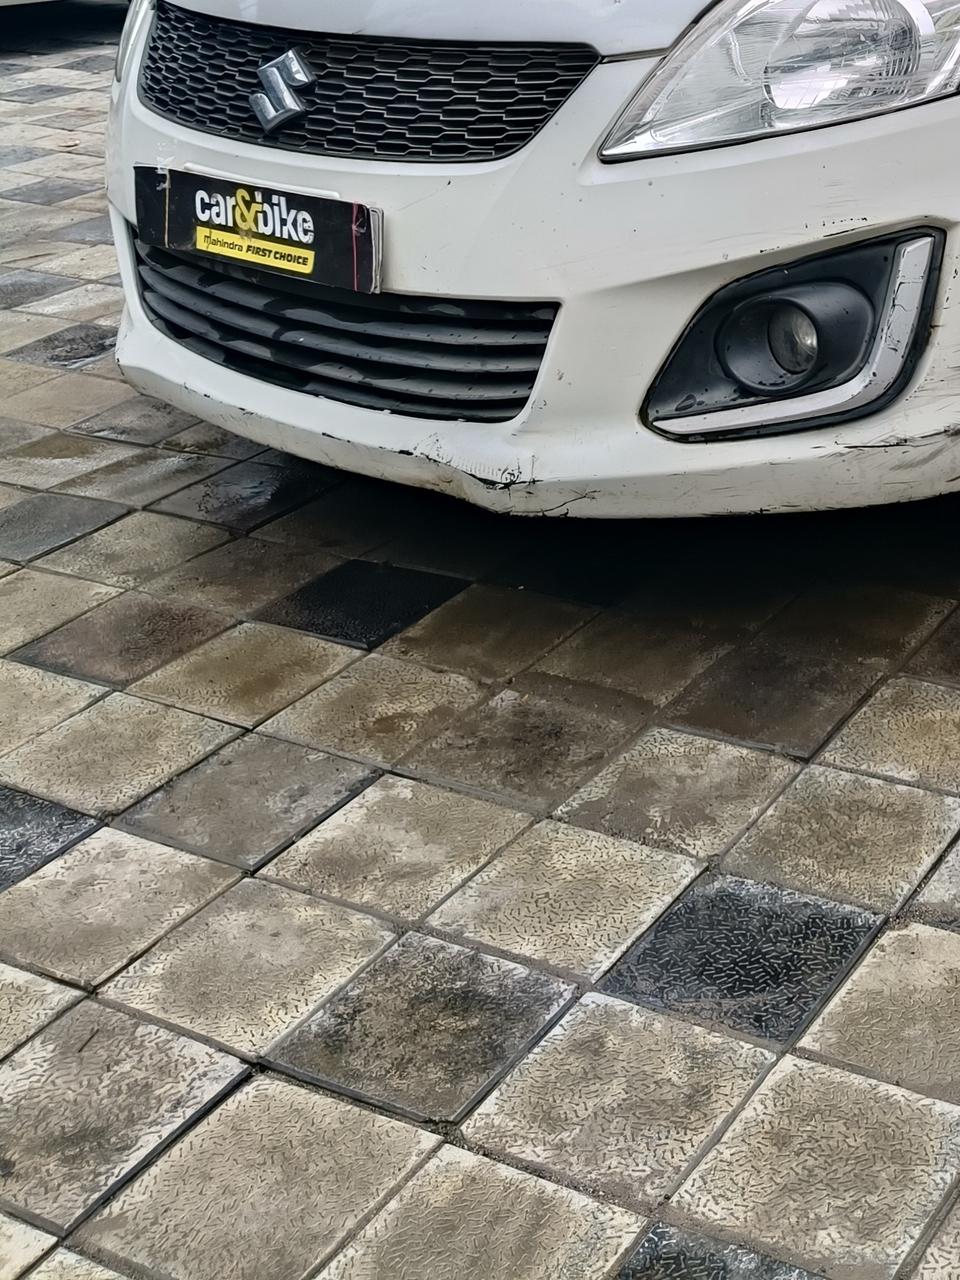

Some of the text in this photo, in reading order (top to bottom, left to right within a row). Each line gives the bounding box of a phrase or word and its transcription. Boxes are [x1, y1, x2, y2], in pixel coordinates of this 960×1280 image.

[195, 187, 315, 244] car&bike
[245, 244, 273, 259] FIRST
[273, 249, 309, 266] CHOICE
